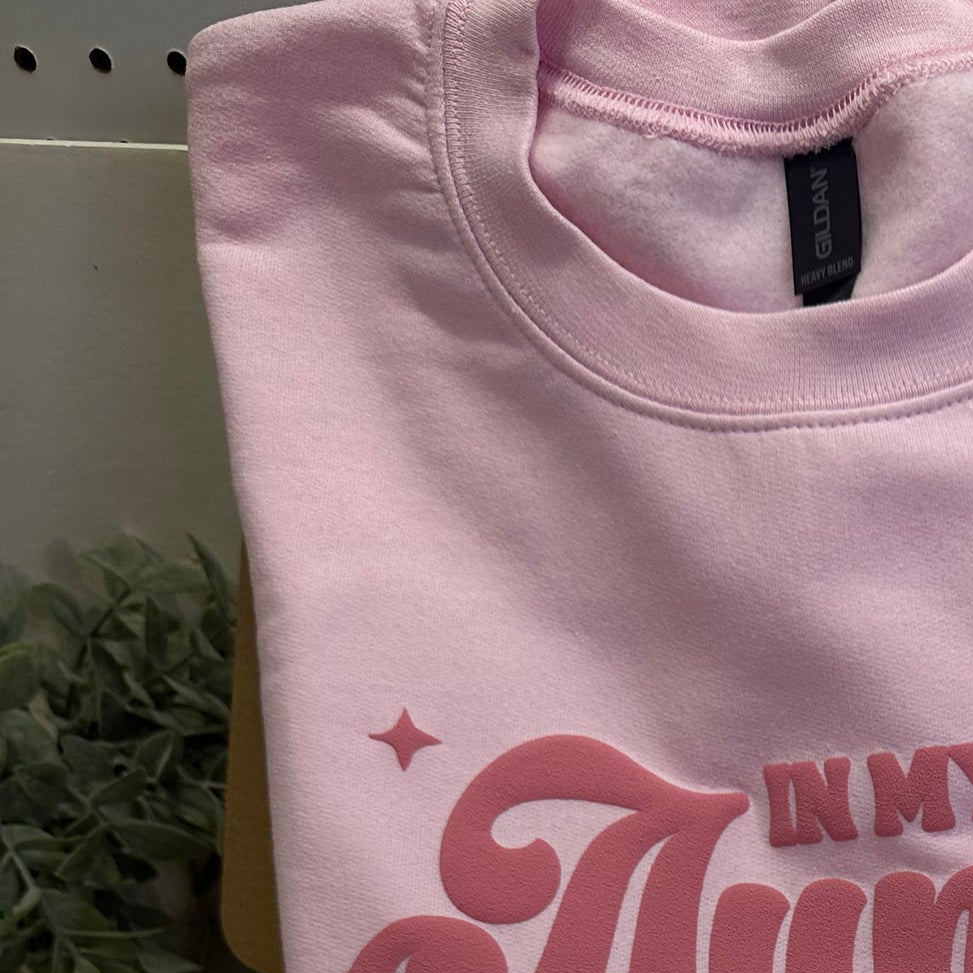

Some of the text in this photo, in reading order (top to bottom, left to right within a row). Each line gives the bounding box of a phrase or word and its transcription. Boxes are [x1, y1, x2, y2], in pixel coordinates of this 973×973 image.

[810, 167, 832, 260] GILDAN
[800, 257, 854, 286] HEAVY BLEND
[763, 757, 858, 847] IN
